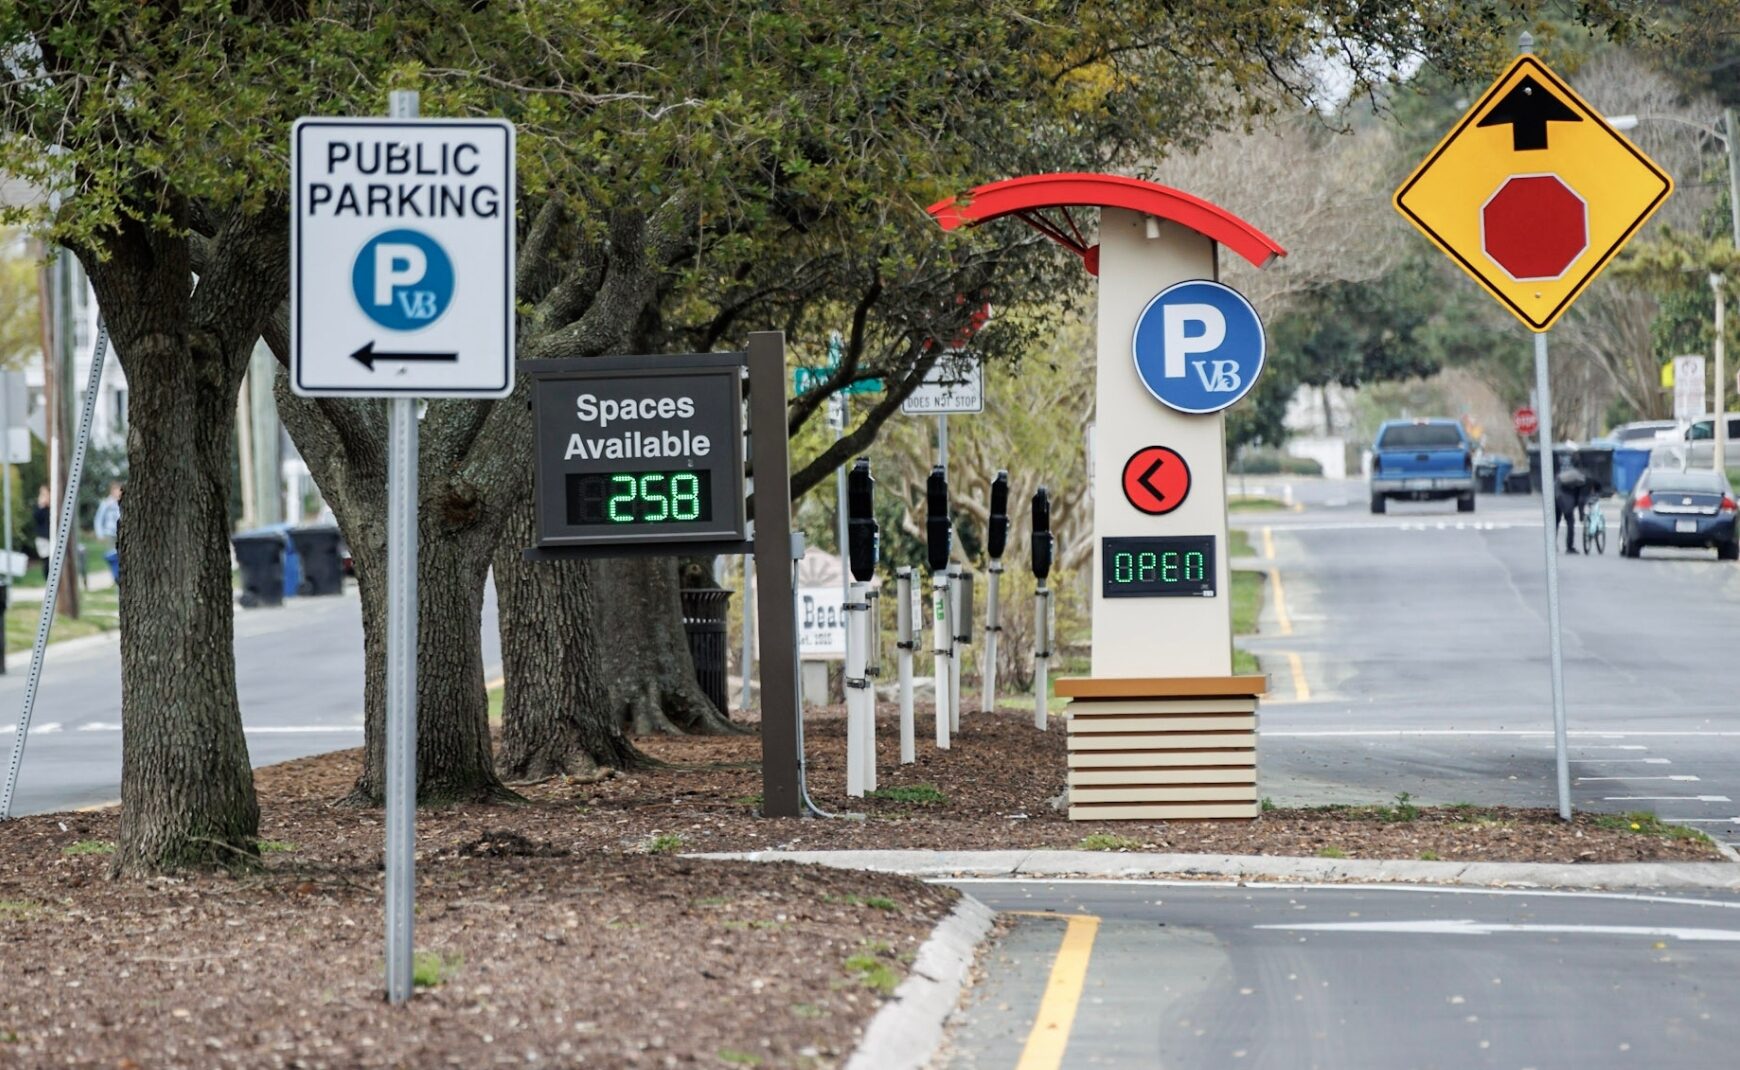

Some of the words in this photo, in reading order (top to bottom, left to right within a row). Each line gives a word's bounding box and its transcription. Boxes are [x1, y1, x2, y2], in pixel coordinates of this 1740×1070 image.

[328, 141, 480, 176] PUBLIC
[309, 183, 500, 218] PARKING
[374, 243, 428, 306] P
[397, 290, 437, 319] VB
[1163, 303, 1226, 378] P
[1191, 359, 1241, 392] VB
[576, 393, 695, 427] Spaces
[907, 396, 930, 408] DOES
[934, 396, 952, 408] NOT
[955, 396, 977, 408] STOP
[563, 429, 711, 461] Available
[609, 474, 699, 522] 258
[1115, 551, 1204, 583] OPEN
